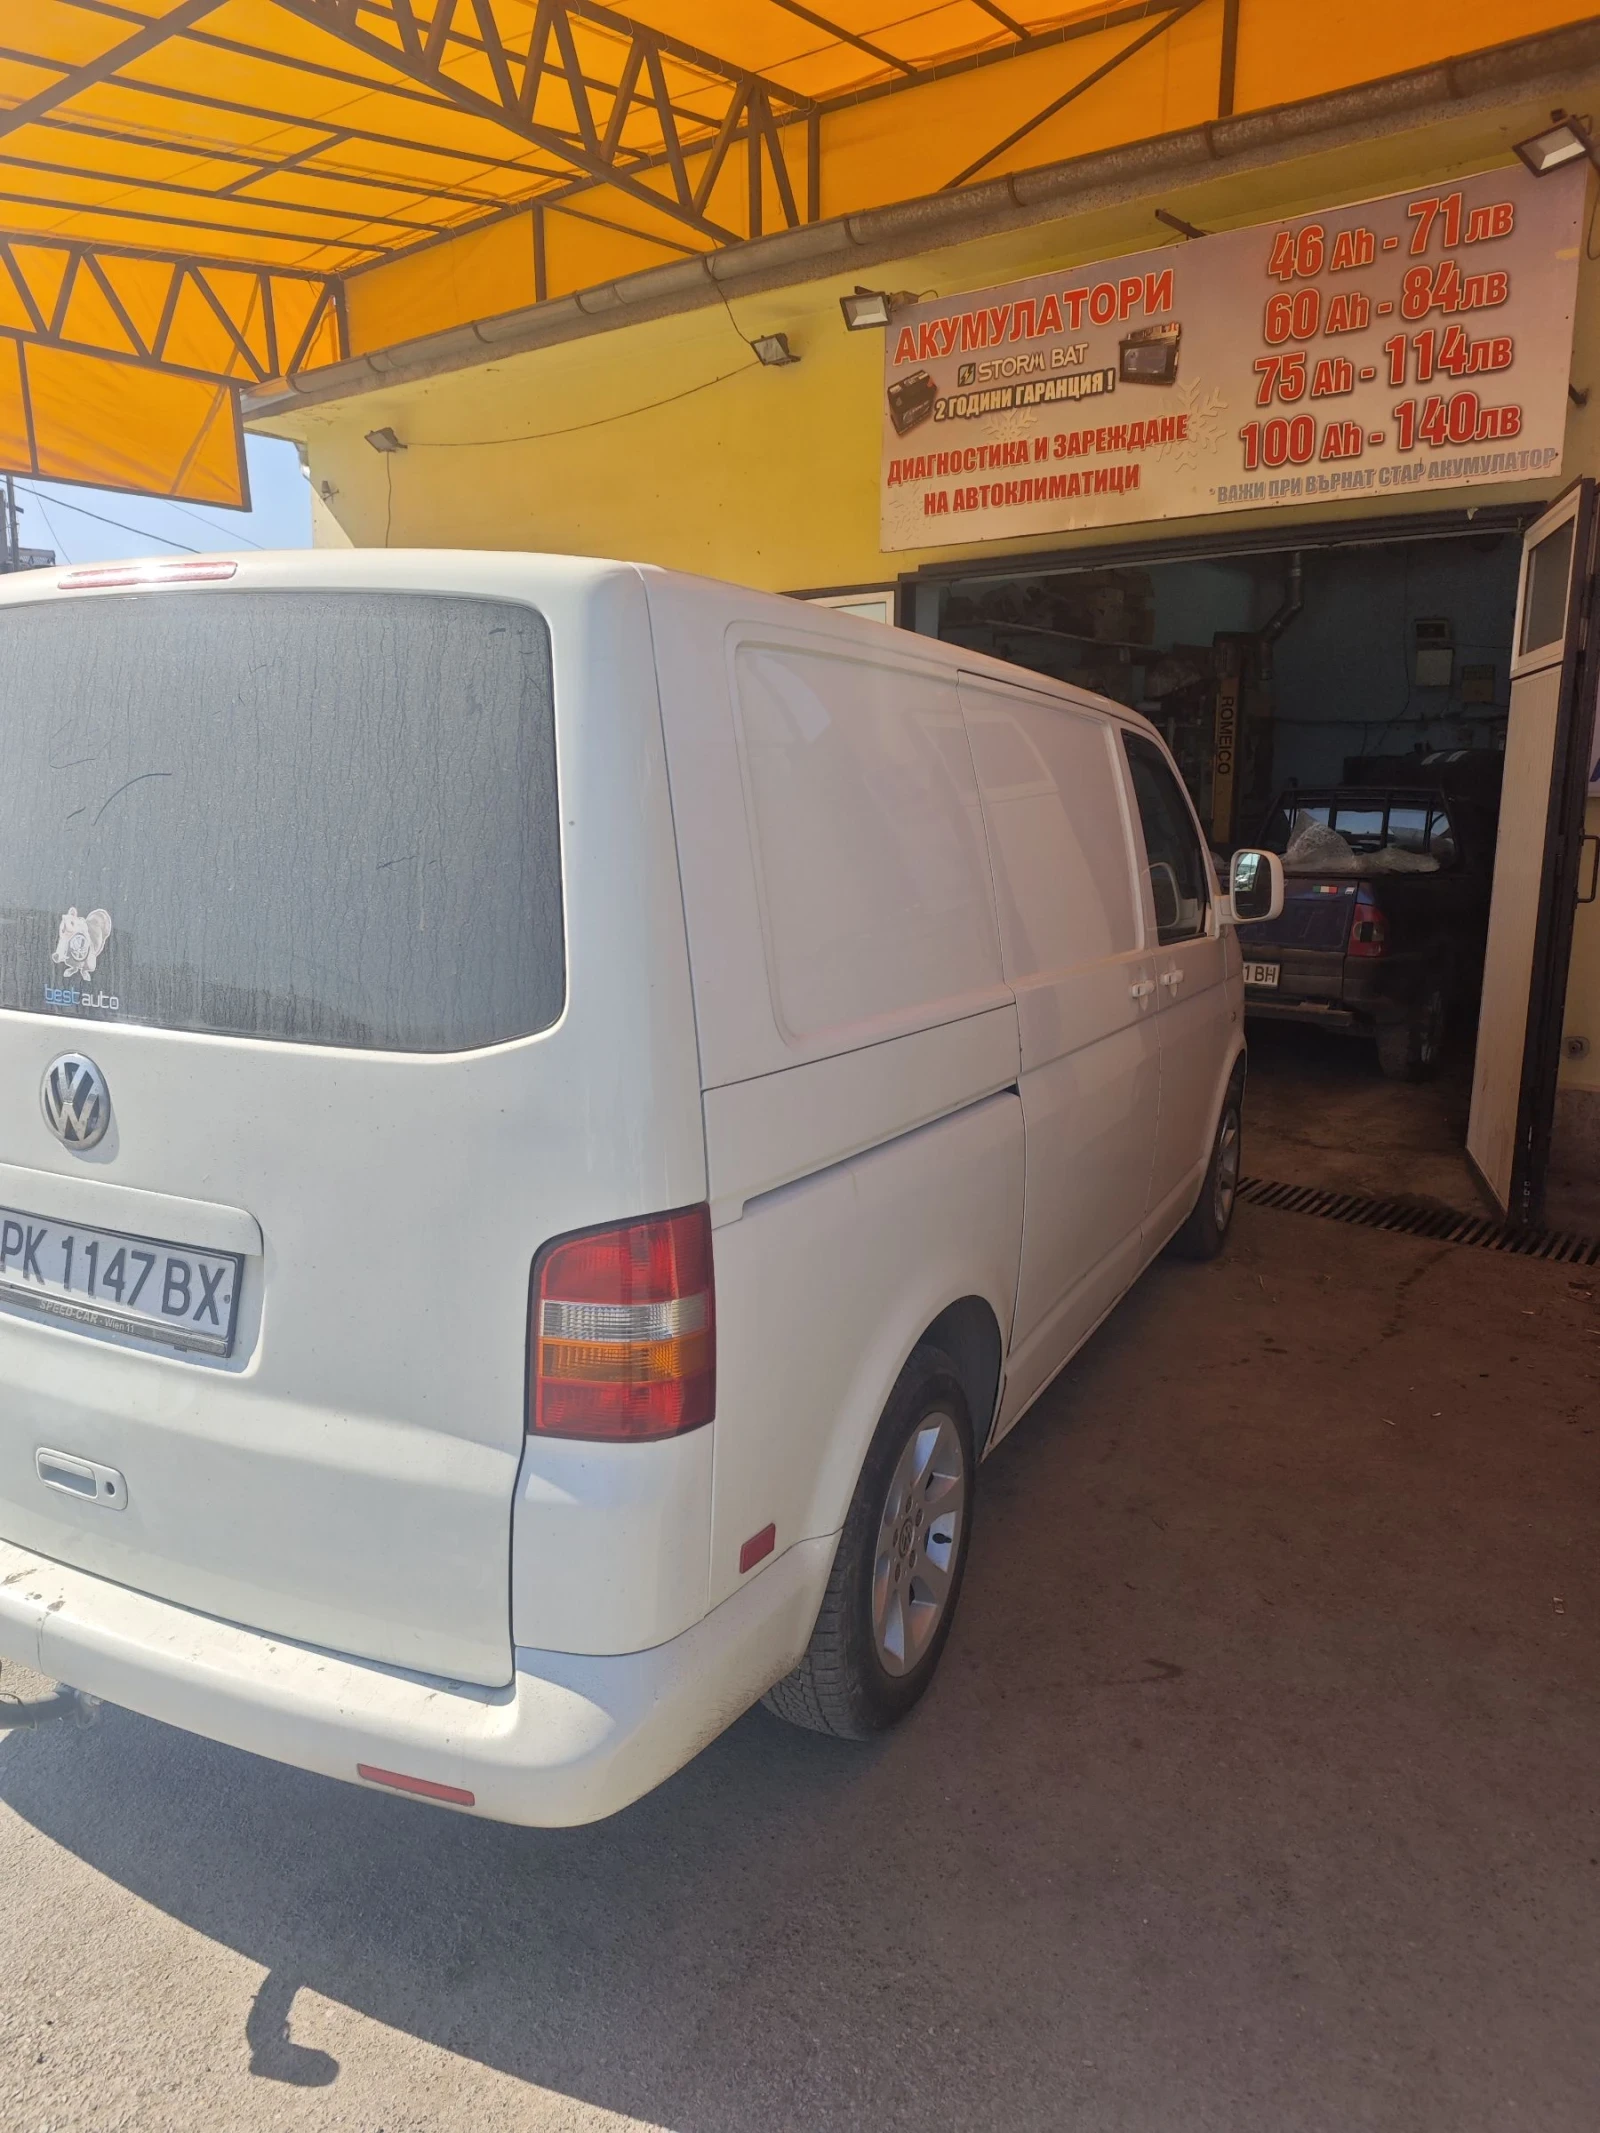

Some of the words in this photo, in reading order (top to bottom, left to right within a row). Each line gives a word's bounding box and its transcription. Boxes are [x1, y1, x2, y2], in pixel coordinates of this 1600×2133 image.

[1268, 224, 1324, 281] 46
[1331, 228, 1375, 271] Ah
[1382, 235, 1398, 250] -
[893, 269, 1174, 366] АКУМУЛАТОРИ
[1264, 288, 1320, 344] 60
[1325, 292, 1370, 334] Ah
[1378, 301, 1393, 314] -
[978, 358, 1046, 383] STORM
[1050, 343, 1089, 369] BAT
[1254, 351, 1306, 405] 75
[1312, 358, 1352, 397] Ah
[1360, 366, 1375, 380] -
[934, 398, 950, 421] 2
[949, 383, 1014, 418] ГОДИНИ
[1015, 372, 1104, 408] ГАРАНЦИЯ
[887, 440, 1029, 487] ДИАГНОСТИКА
[1035, 436, 1048, 461] И
[1053, 414, 1188, 459] ЗАРЕЖДАНЕ
[1240, 414, 1315, 469] 100
[1320, 421, 1361, 460] Ah
[1370, 431, 1384, 444] -
[923, 490, 948, 516] НА
[952, 464, 1140, 512] АВТОКЛИМАТИЦИ
[1269, 478, 1301, 497] ПРИ
[1305, 467, 1375, 493] ВЪРНАТ
[1378, 461, 1425, 485] СТАР
[1427, 447, 1556, 480] АКУМУЛАТОР
[1218, 696, 1234, 774] ROMEICO
[1255, 966, 1276, 983] BH
[0, 1220, 48, 1286] PK
[61, 1235, 157, 1306] 1147
[161, 1257, 226, 1326] BX
[39, 1299, 99, 1324] SPEED-CAR
[104, 1317, 125, 1330] Wien
